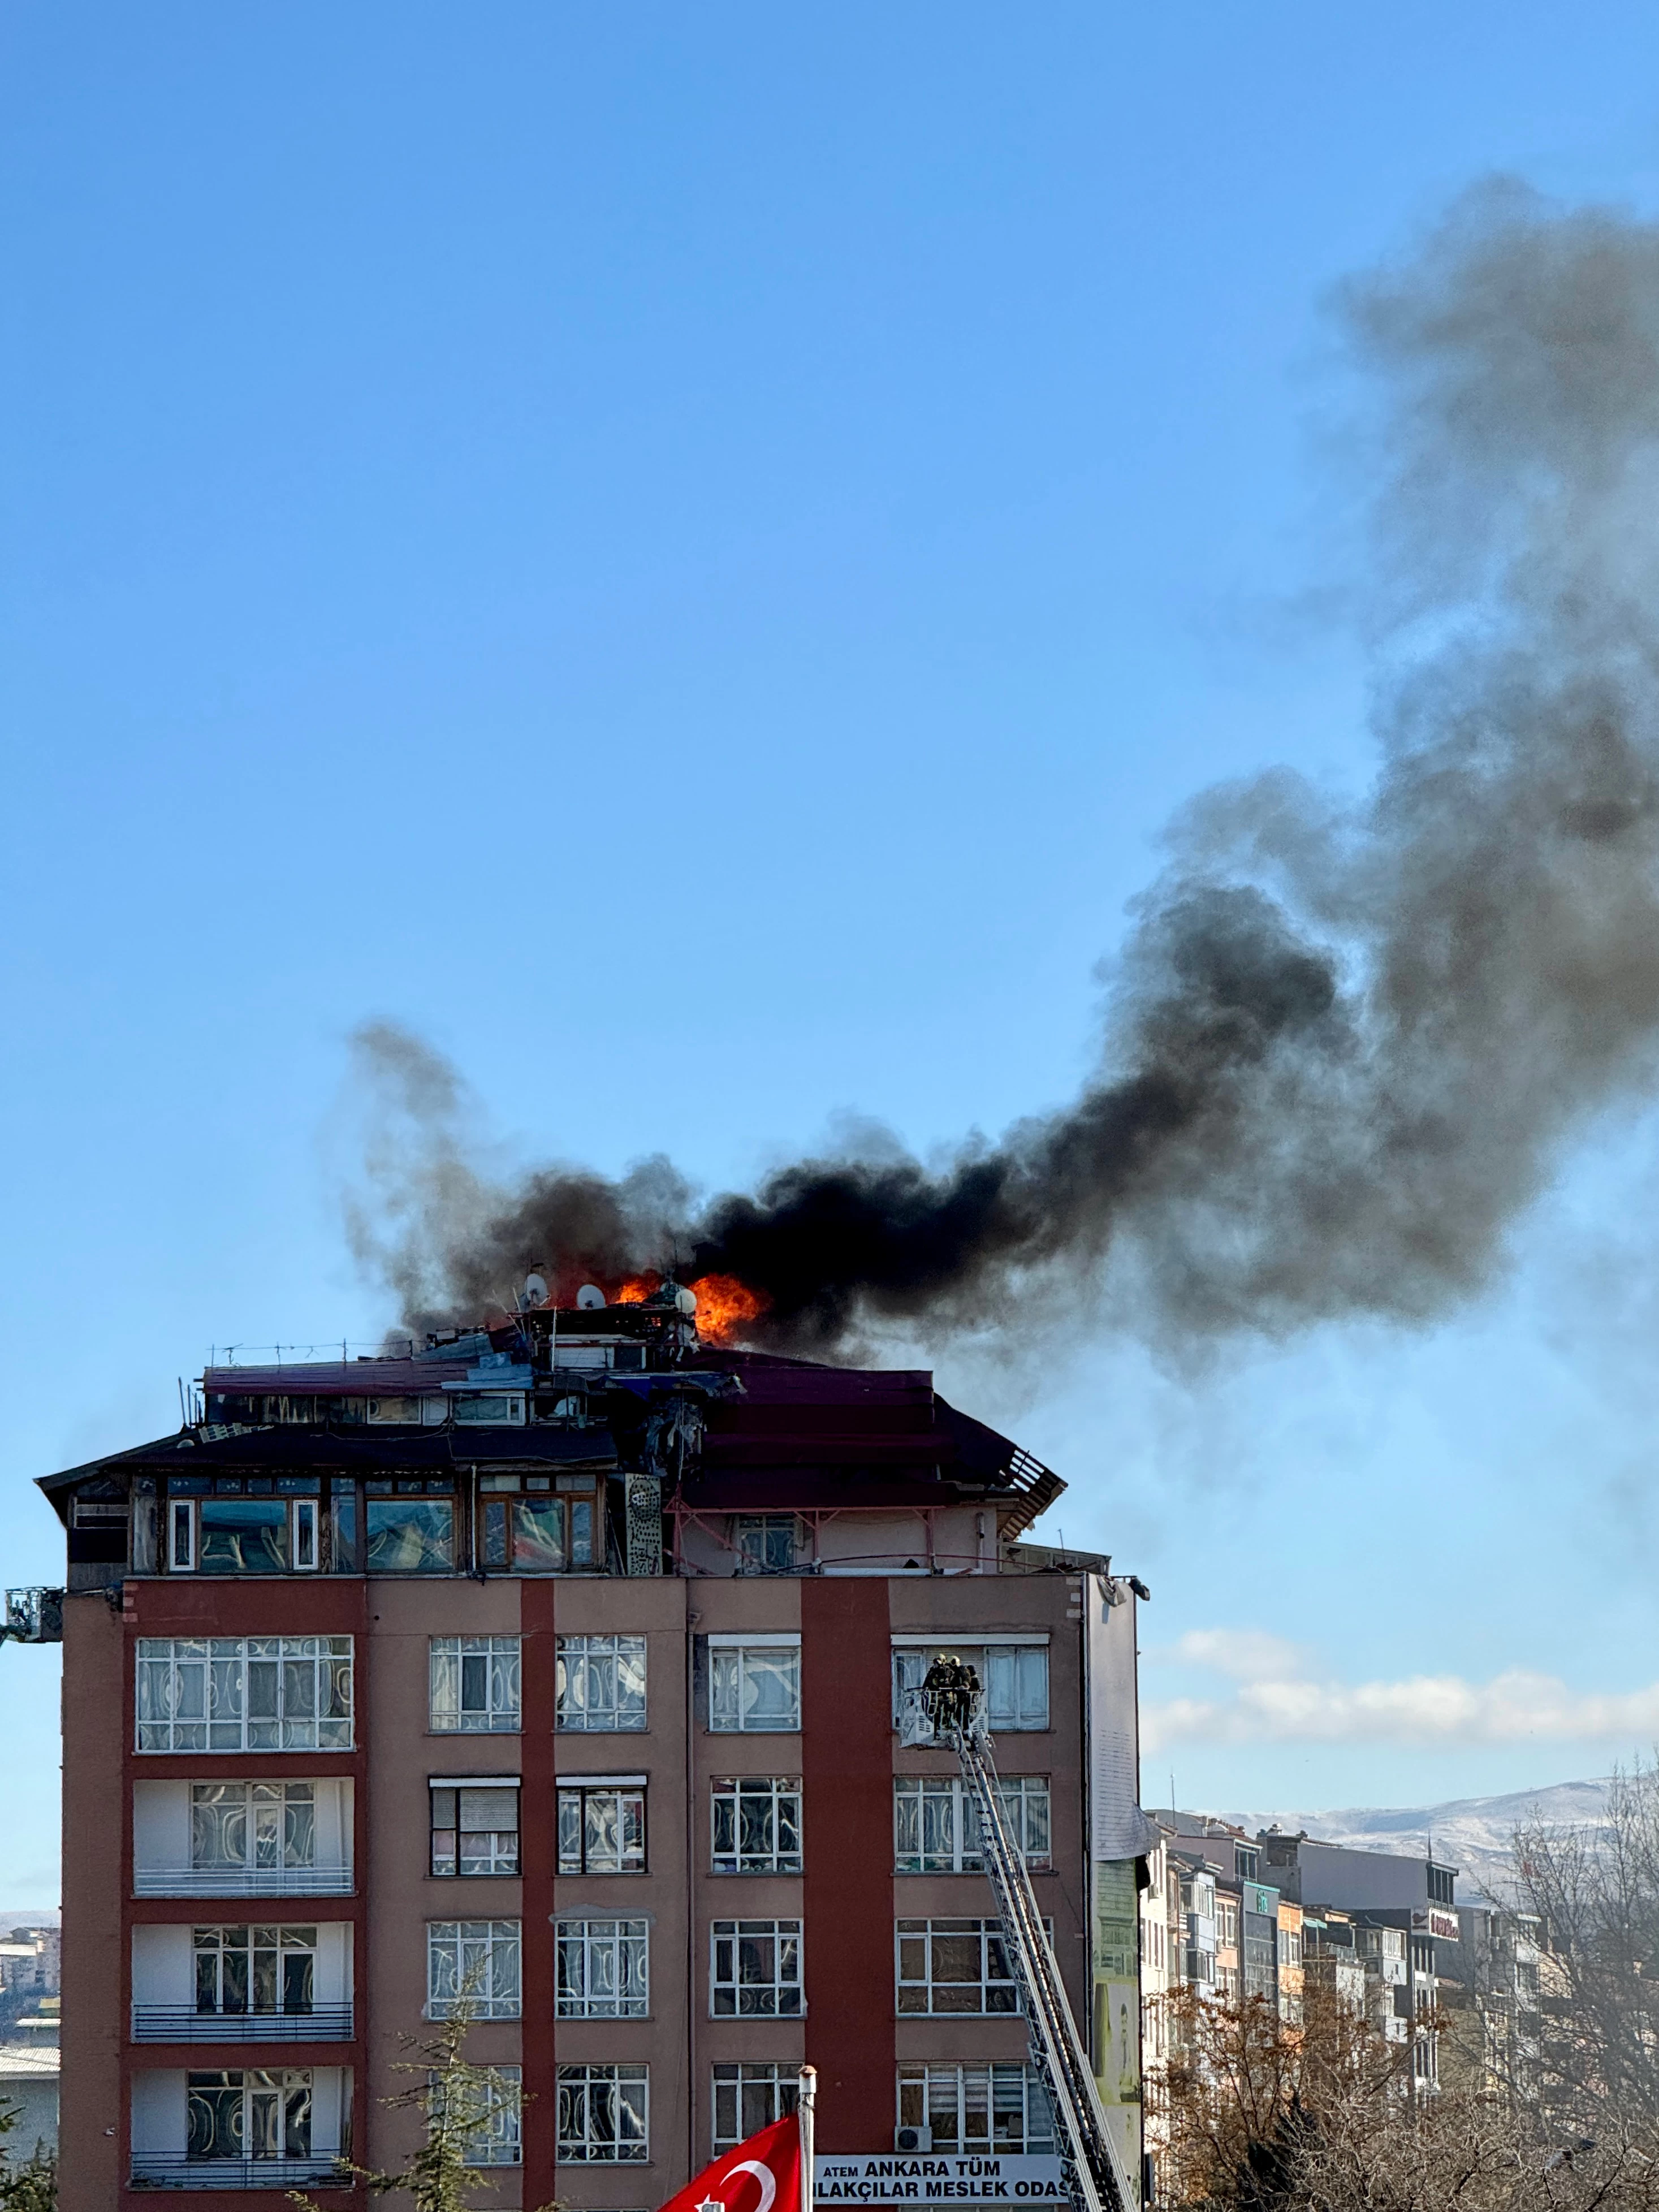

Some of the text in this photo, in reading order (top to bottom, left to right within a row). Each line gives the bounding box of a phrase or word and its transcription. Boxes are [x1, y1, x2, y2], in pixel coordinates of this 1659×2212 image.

[823, 2157, 1000, 2177] ATEM ANKARA TÜM
[813, 2181, 918, 2202] LAKÇILAR
[926, 2181, 1008, 2197] MESLEK
